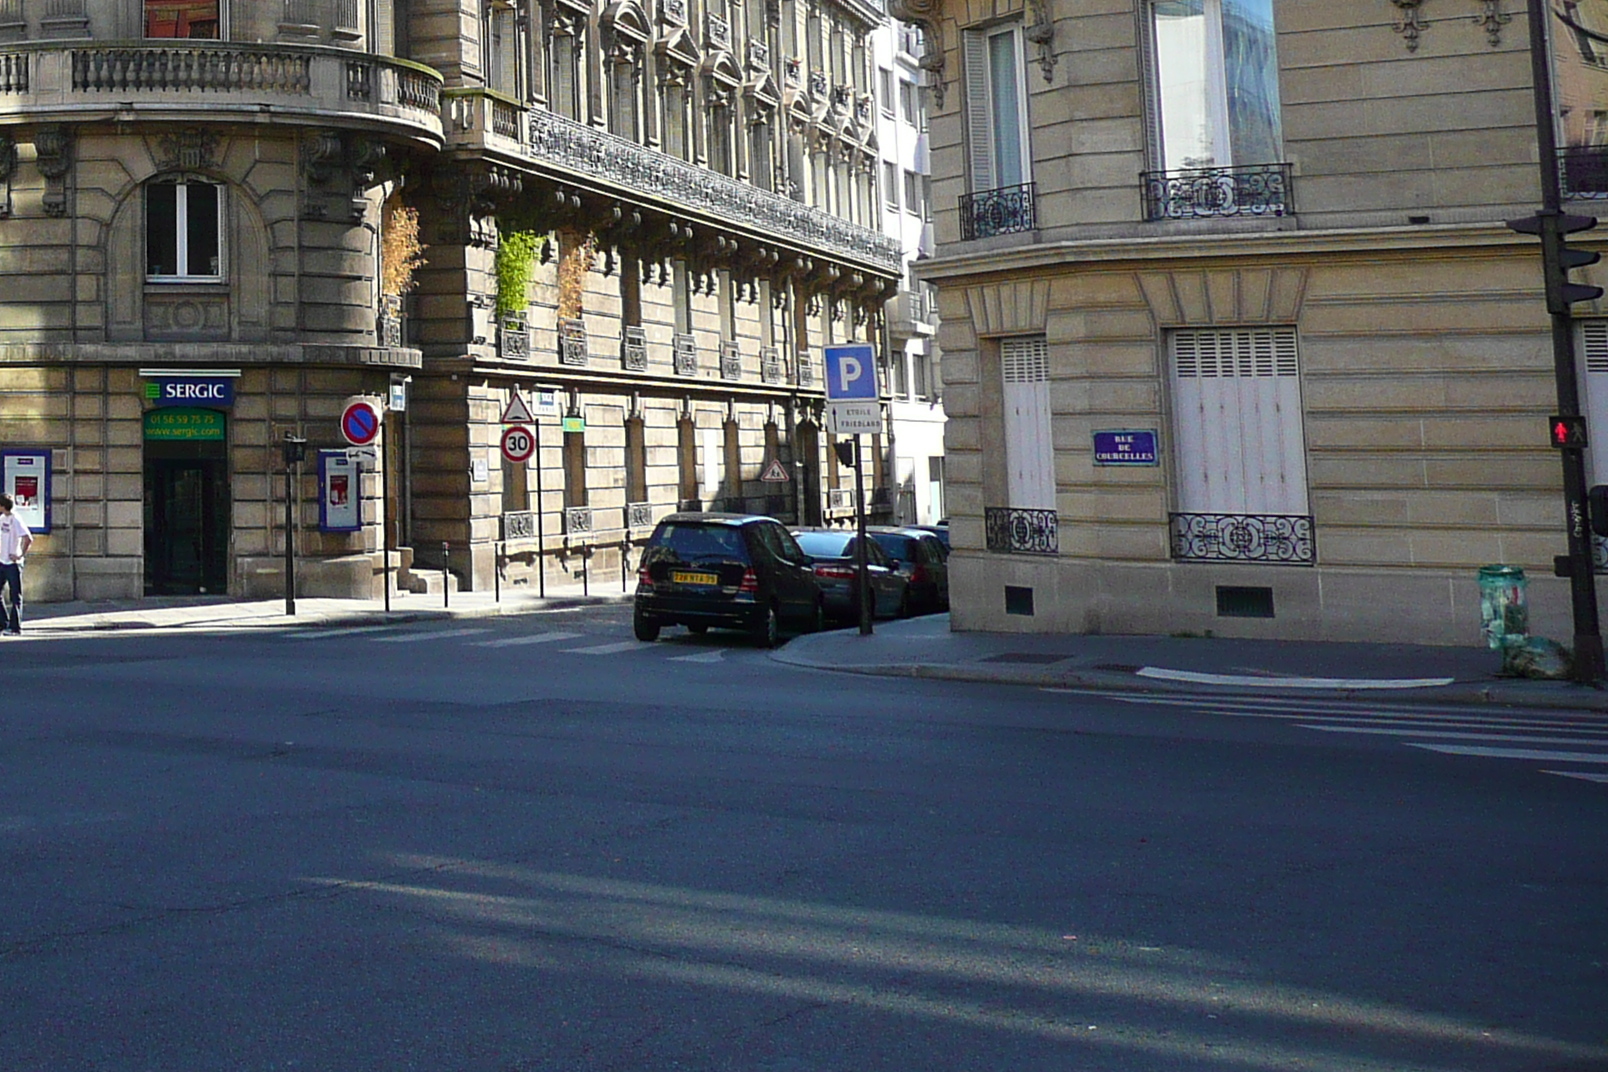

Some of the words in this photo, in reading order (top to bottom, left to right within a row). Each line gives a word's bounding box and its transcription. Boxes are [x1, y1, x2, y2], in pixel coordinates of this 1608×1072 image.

[839, 356, 862, 392] P
[165, 383, 225, 399] SERGIC
[508, 436, 528, 451] 30
[1114, 435, 1134, 443] RUE
[1096, 452, 1153, 460] COURCELLES
